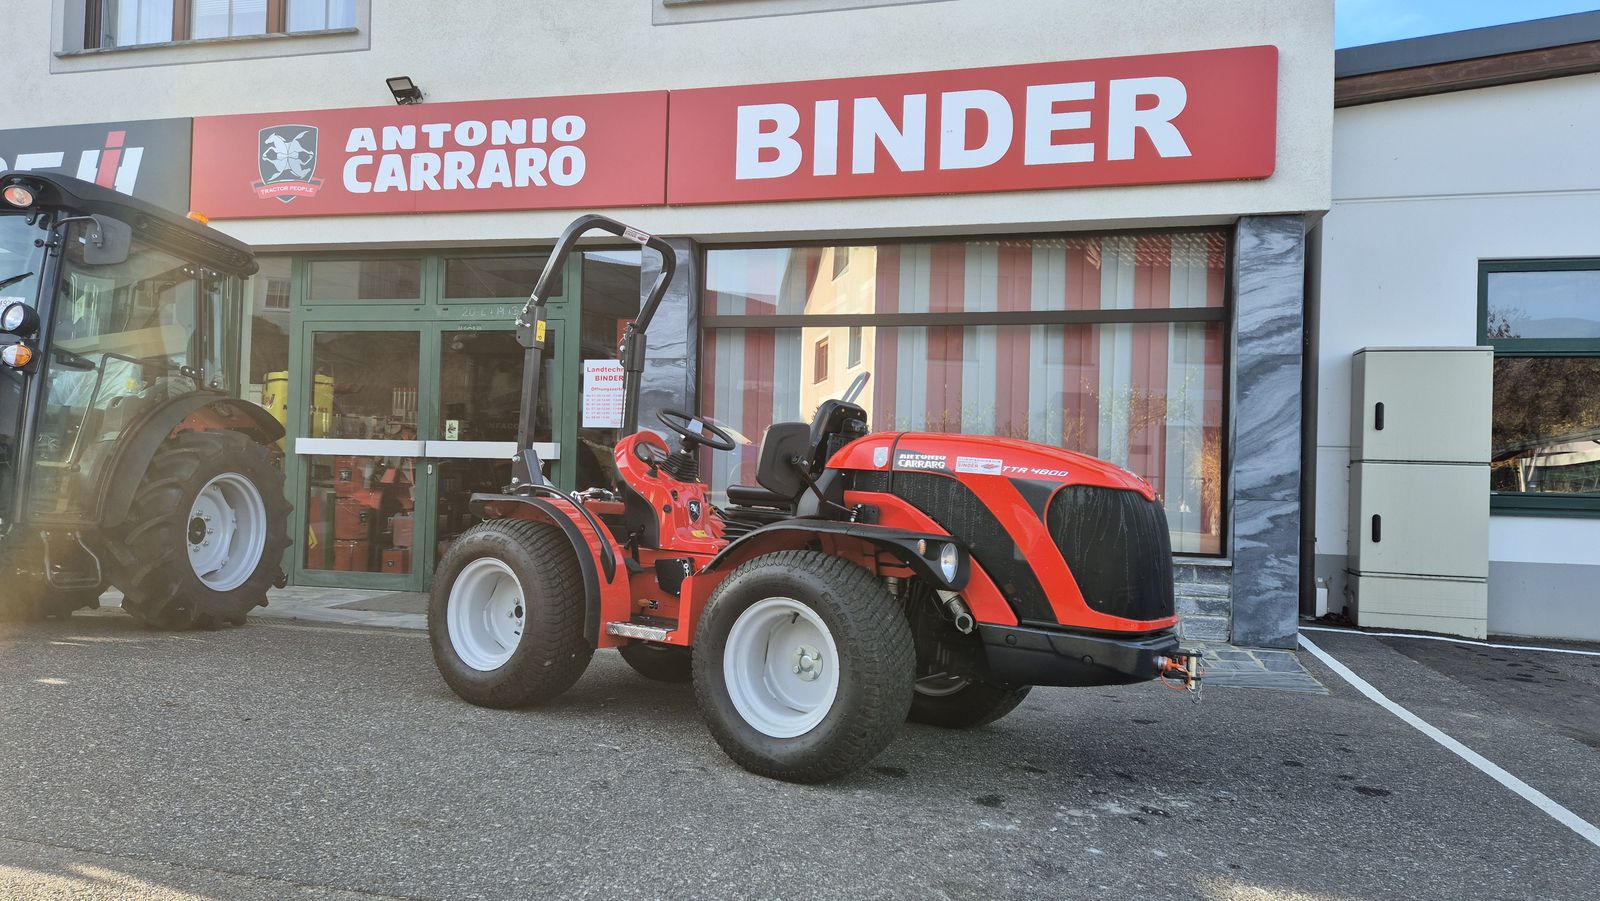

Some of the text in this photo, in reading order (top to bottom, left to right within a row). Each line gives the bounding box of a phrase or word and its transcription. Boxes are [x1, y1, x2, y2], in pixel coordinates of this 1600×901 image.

[345, 115, 586, 153] ANTONIO
[735, 76, 1193, 181] BINDER
[343, 145, 586, 193] CARRARO
[261, 186, 288, 195] TRACTOR
[898, 459, 946, 469] CARRARO
[1002, 465, 1028, 473] TTR
